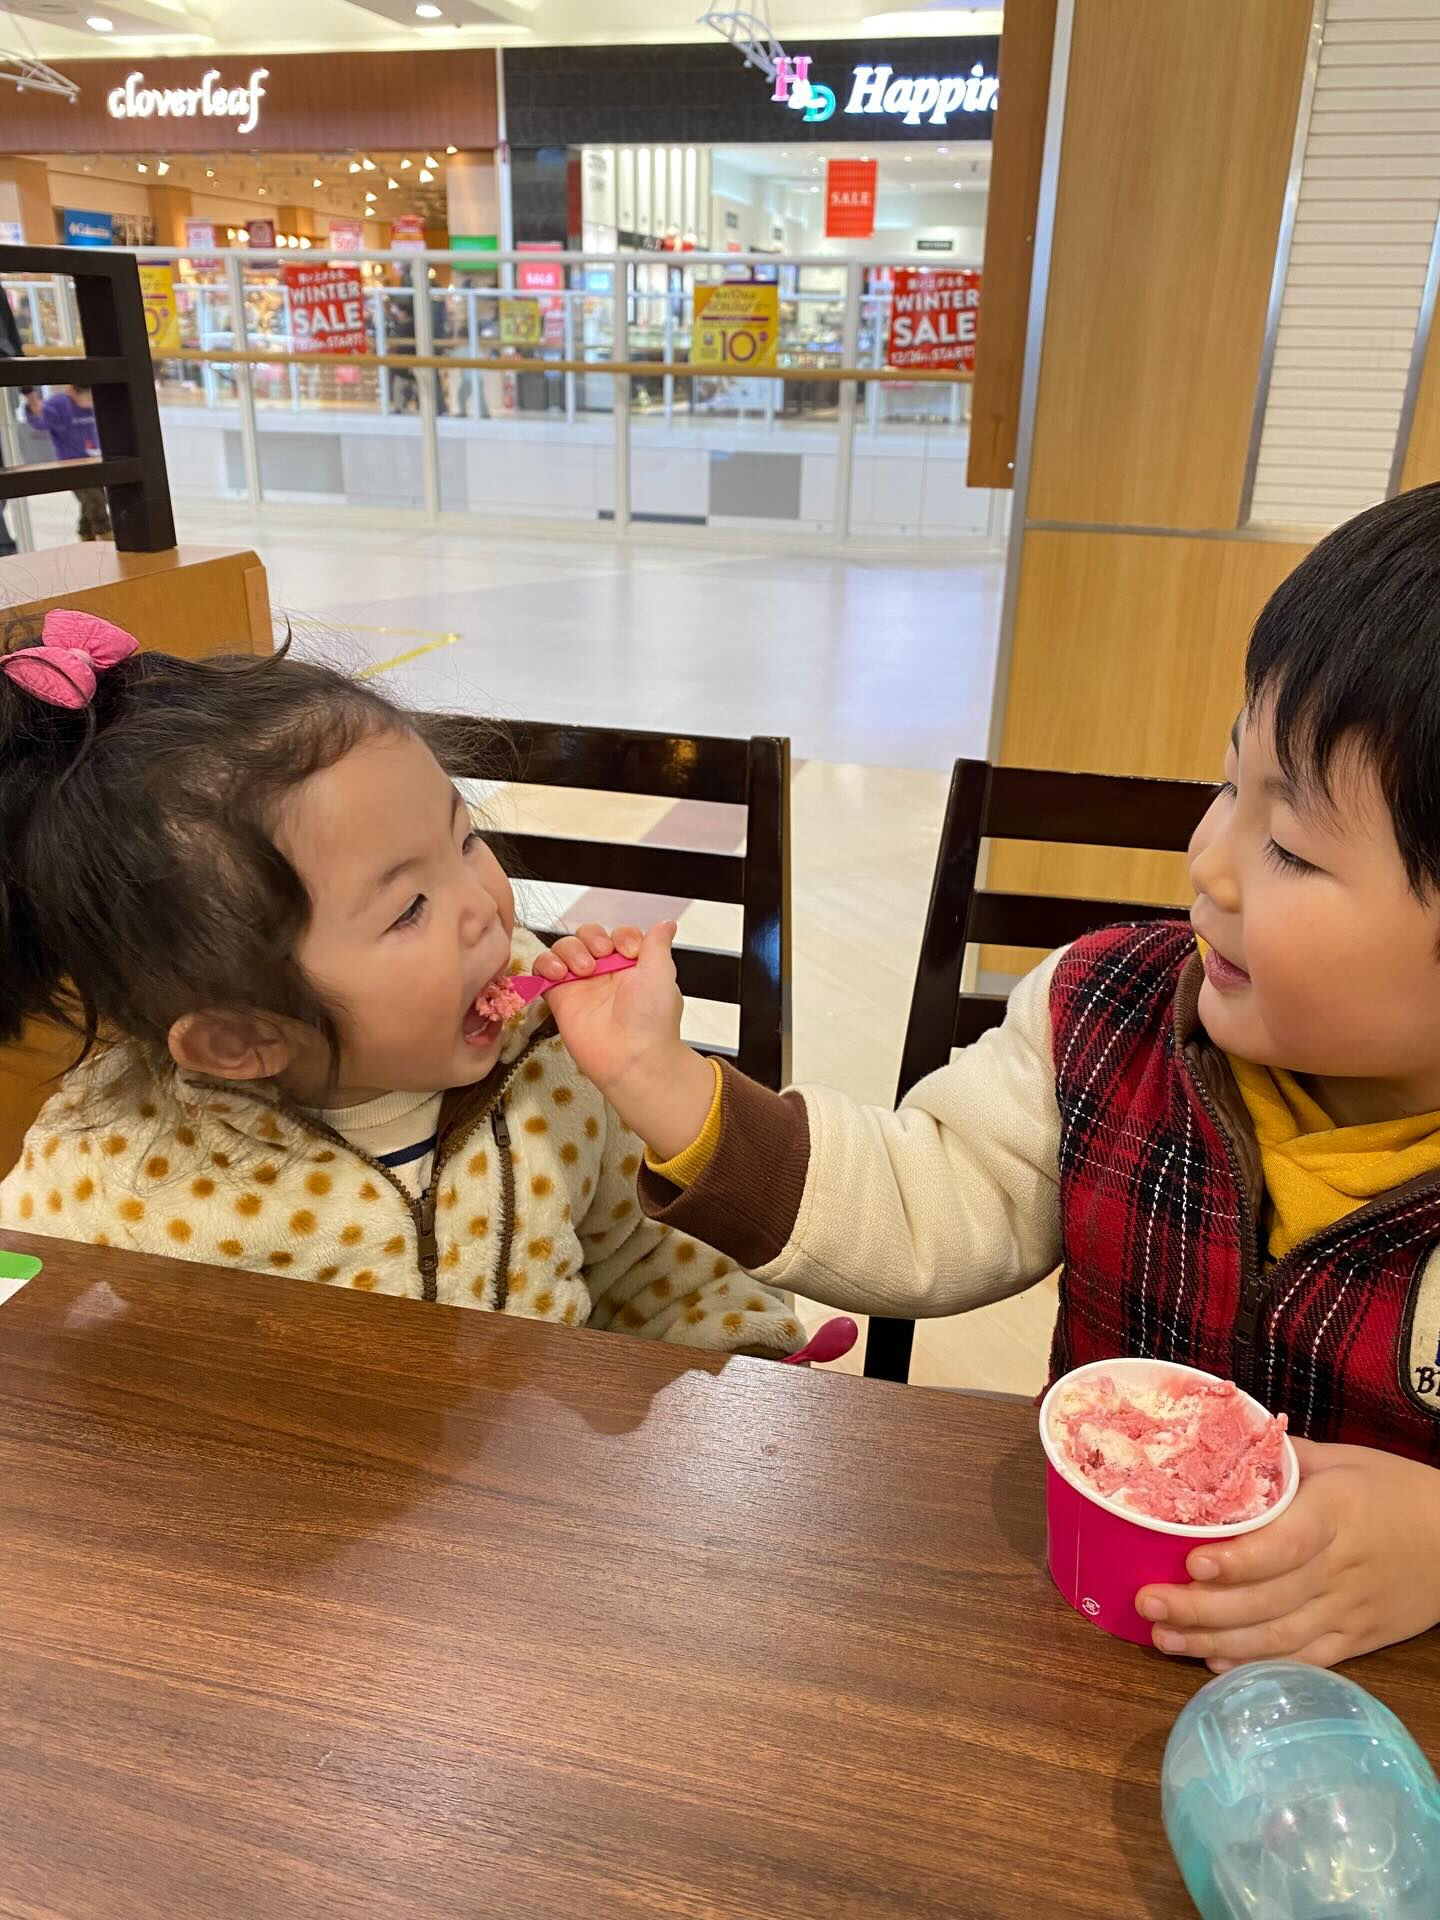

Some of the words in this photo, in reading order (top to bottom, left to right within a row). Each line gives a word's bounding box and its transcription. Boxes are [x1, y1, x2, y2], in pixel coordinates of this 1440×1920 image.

[107, 67, 269, 134] cloverleaf
[831, 191, 869, 206] SALE
[290, 281, 361, 304] WINTER
[895, 288, 980, 312] WINTER
[294, 302, 362, 335] SALE
[893, 312, 976, 347] SALE
